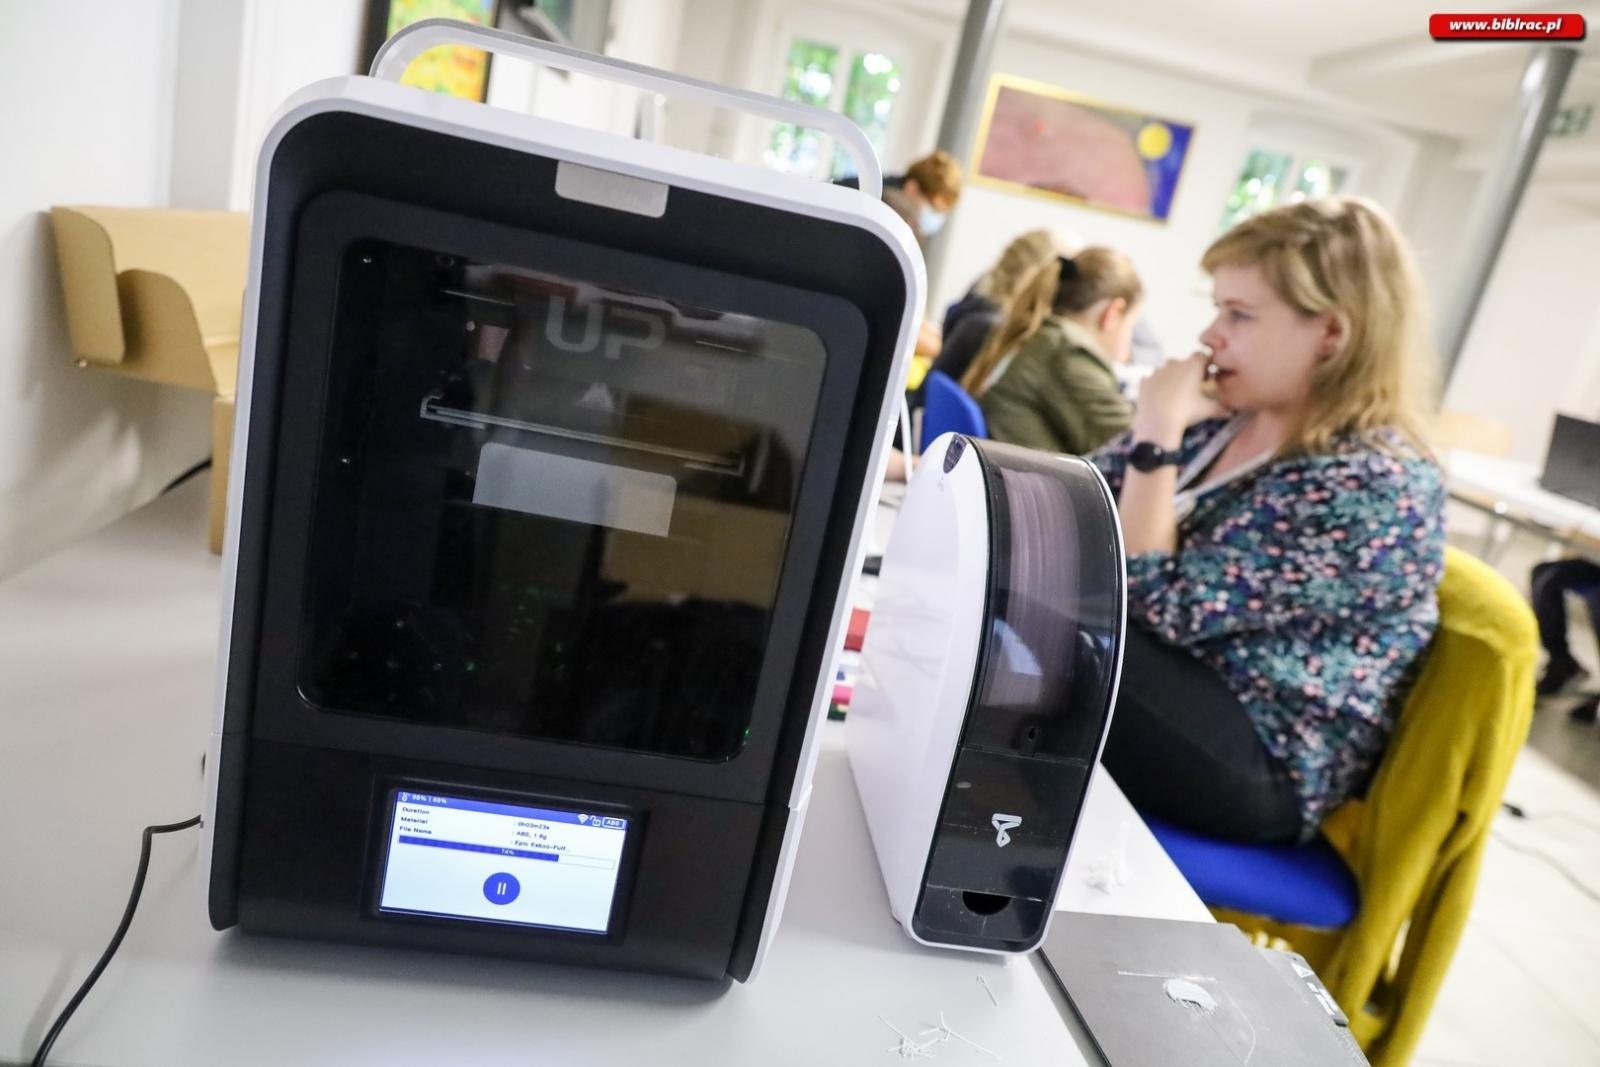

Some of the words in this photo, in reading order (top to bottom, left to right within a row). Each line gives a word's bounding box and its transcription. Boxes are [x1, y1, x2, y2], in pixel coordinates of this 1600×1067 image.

[546, 295, 666, 359] UP
[402, 806, 430, 814] Duration
[400, 816, 428, 824] Material
